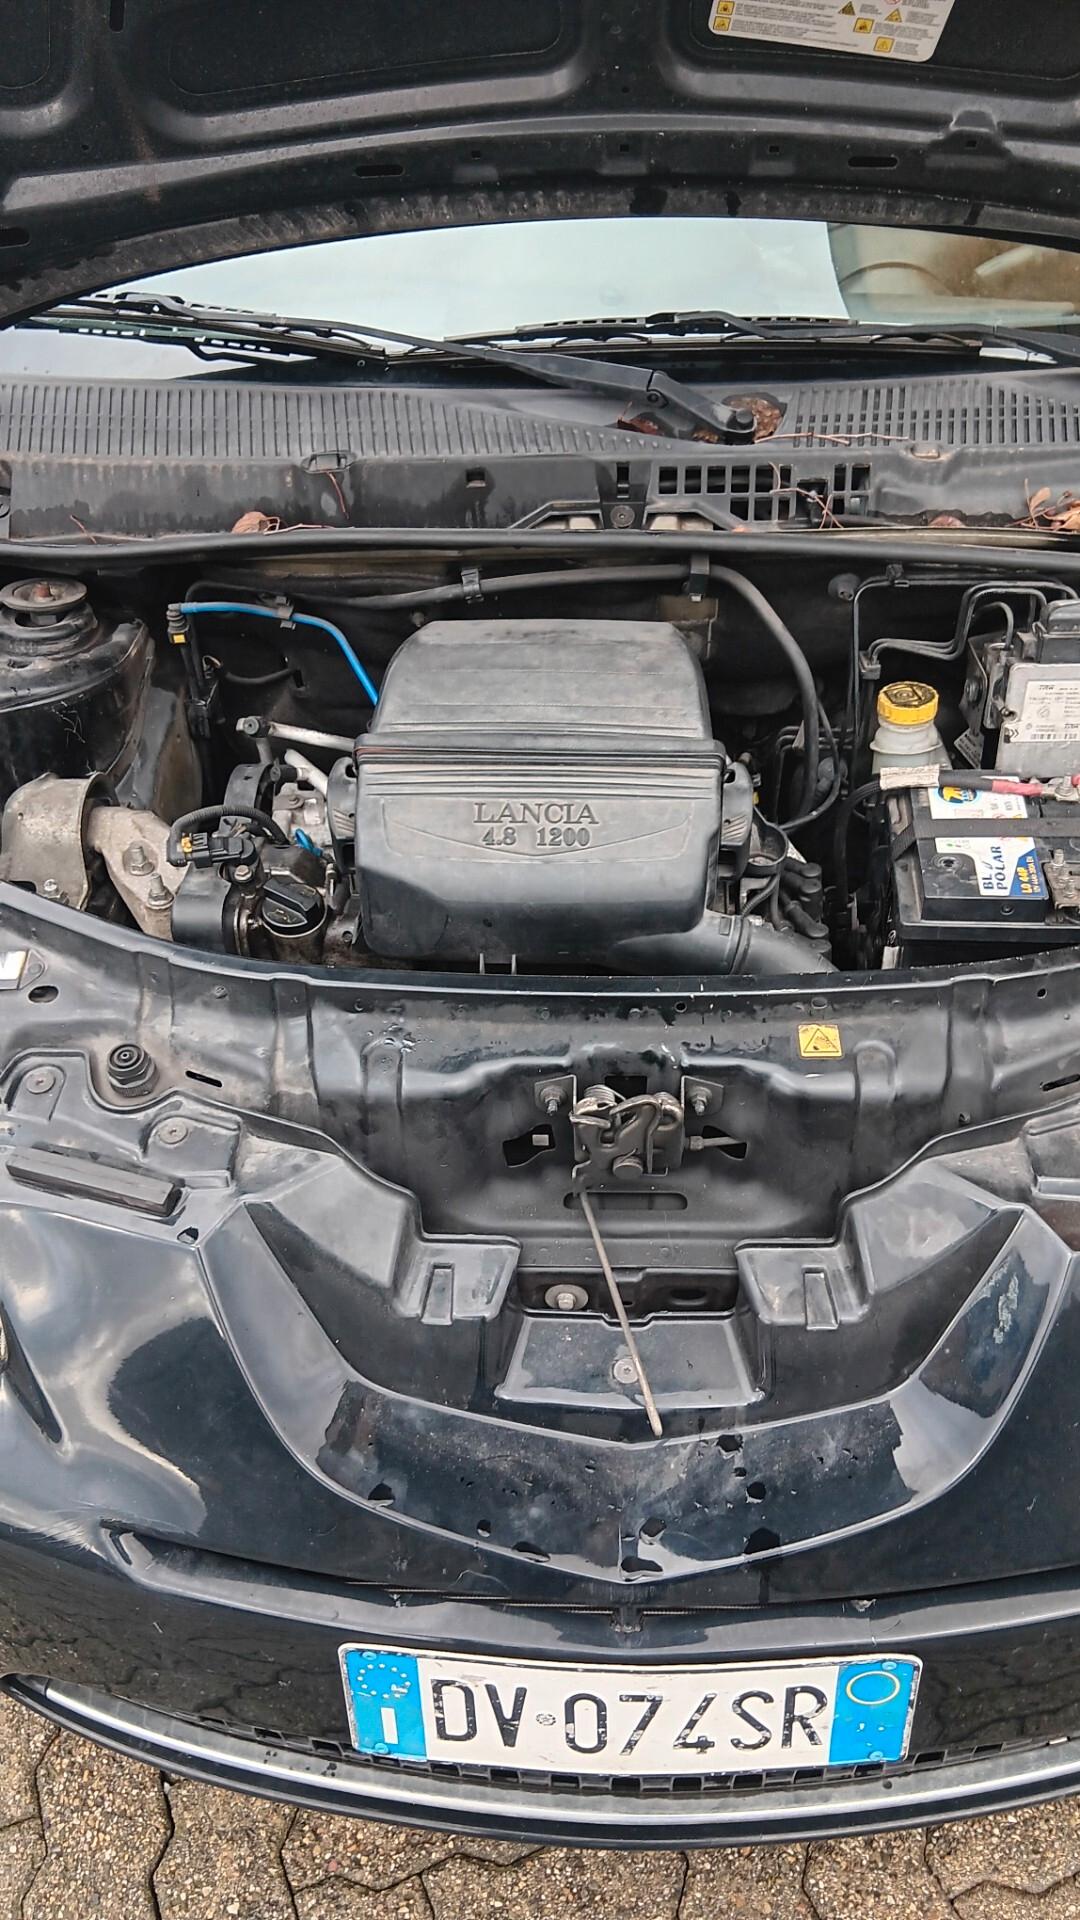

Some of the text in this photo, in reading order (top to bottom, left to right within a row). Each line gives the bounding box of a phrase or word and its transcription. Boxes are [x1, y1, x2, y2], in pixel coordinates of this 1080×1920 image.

[473, 802, 599, 824] LANCIA
[482, 826, 591, 846] 4.8 1200
[990, 846, 1008, 890] POLAR
[430, 1679, 828, 1756] DV 074SR
